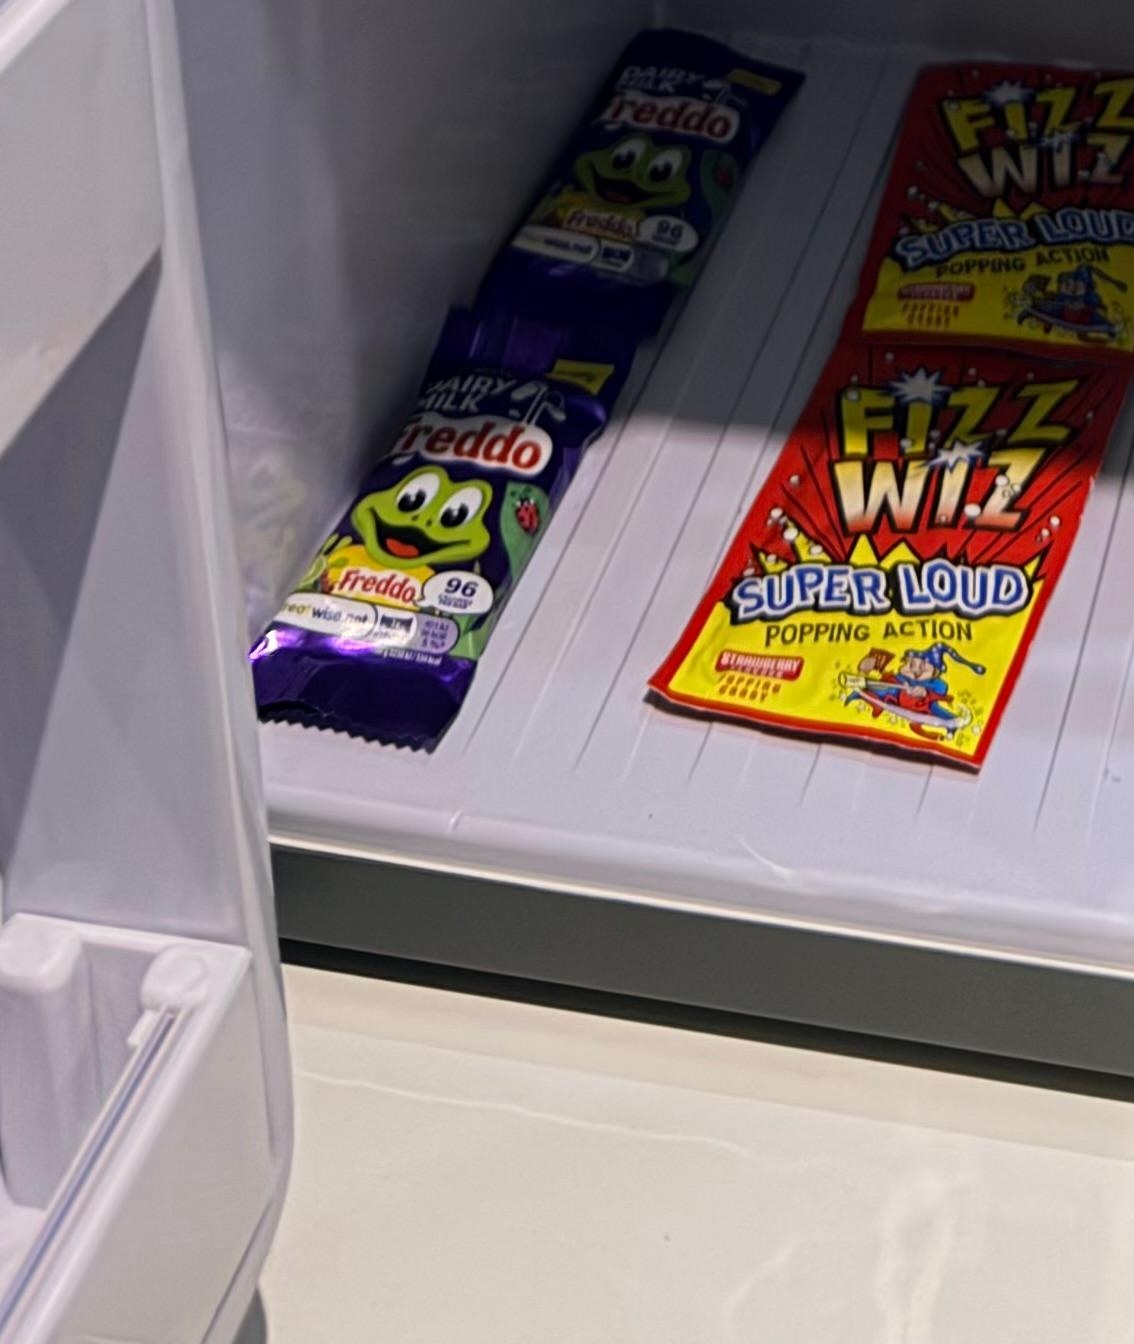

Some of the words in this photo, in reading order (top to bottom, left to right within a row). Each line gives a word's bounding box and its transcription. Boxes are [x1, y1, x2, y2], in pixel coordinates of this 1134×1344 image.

[957, 133, 1132, 199] WIZ
[656, 219, 684, 240] 96
[896, 218, 1034, 270] SUPER
[936, 257, 1025, 278] POPPING
[1035, 247, 1110, 265] ACTION
[841, 378, 1079, 456] FIZZ
[833, 448, 1047, 533] WIZ
[339, 569, 417, 603] Freddo
[445, 577, 479, 598] 96
[731, 563, 890, 619] SUPER
[900, 558, 1030, 614] LOUD
[765, 620, 870, 647] POPPING
[884, 619, 973, 641] ACTION
